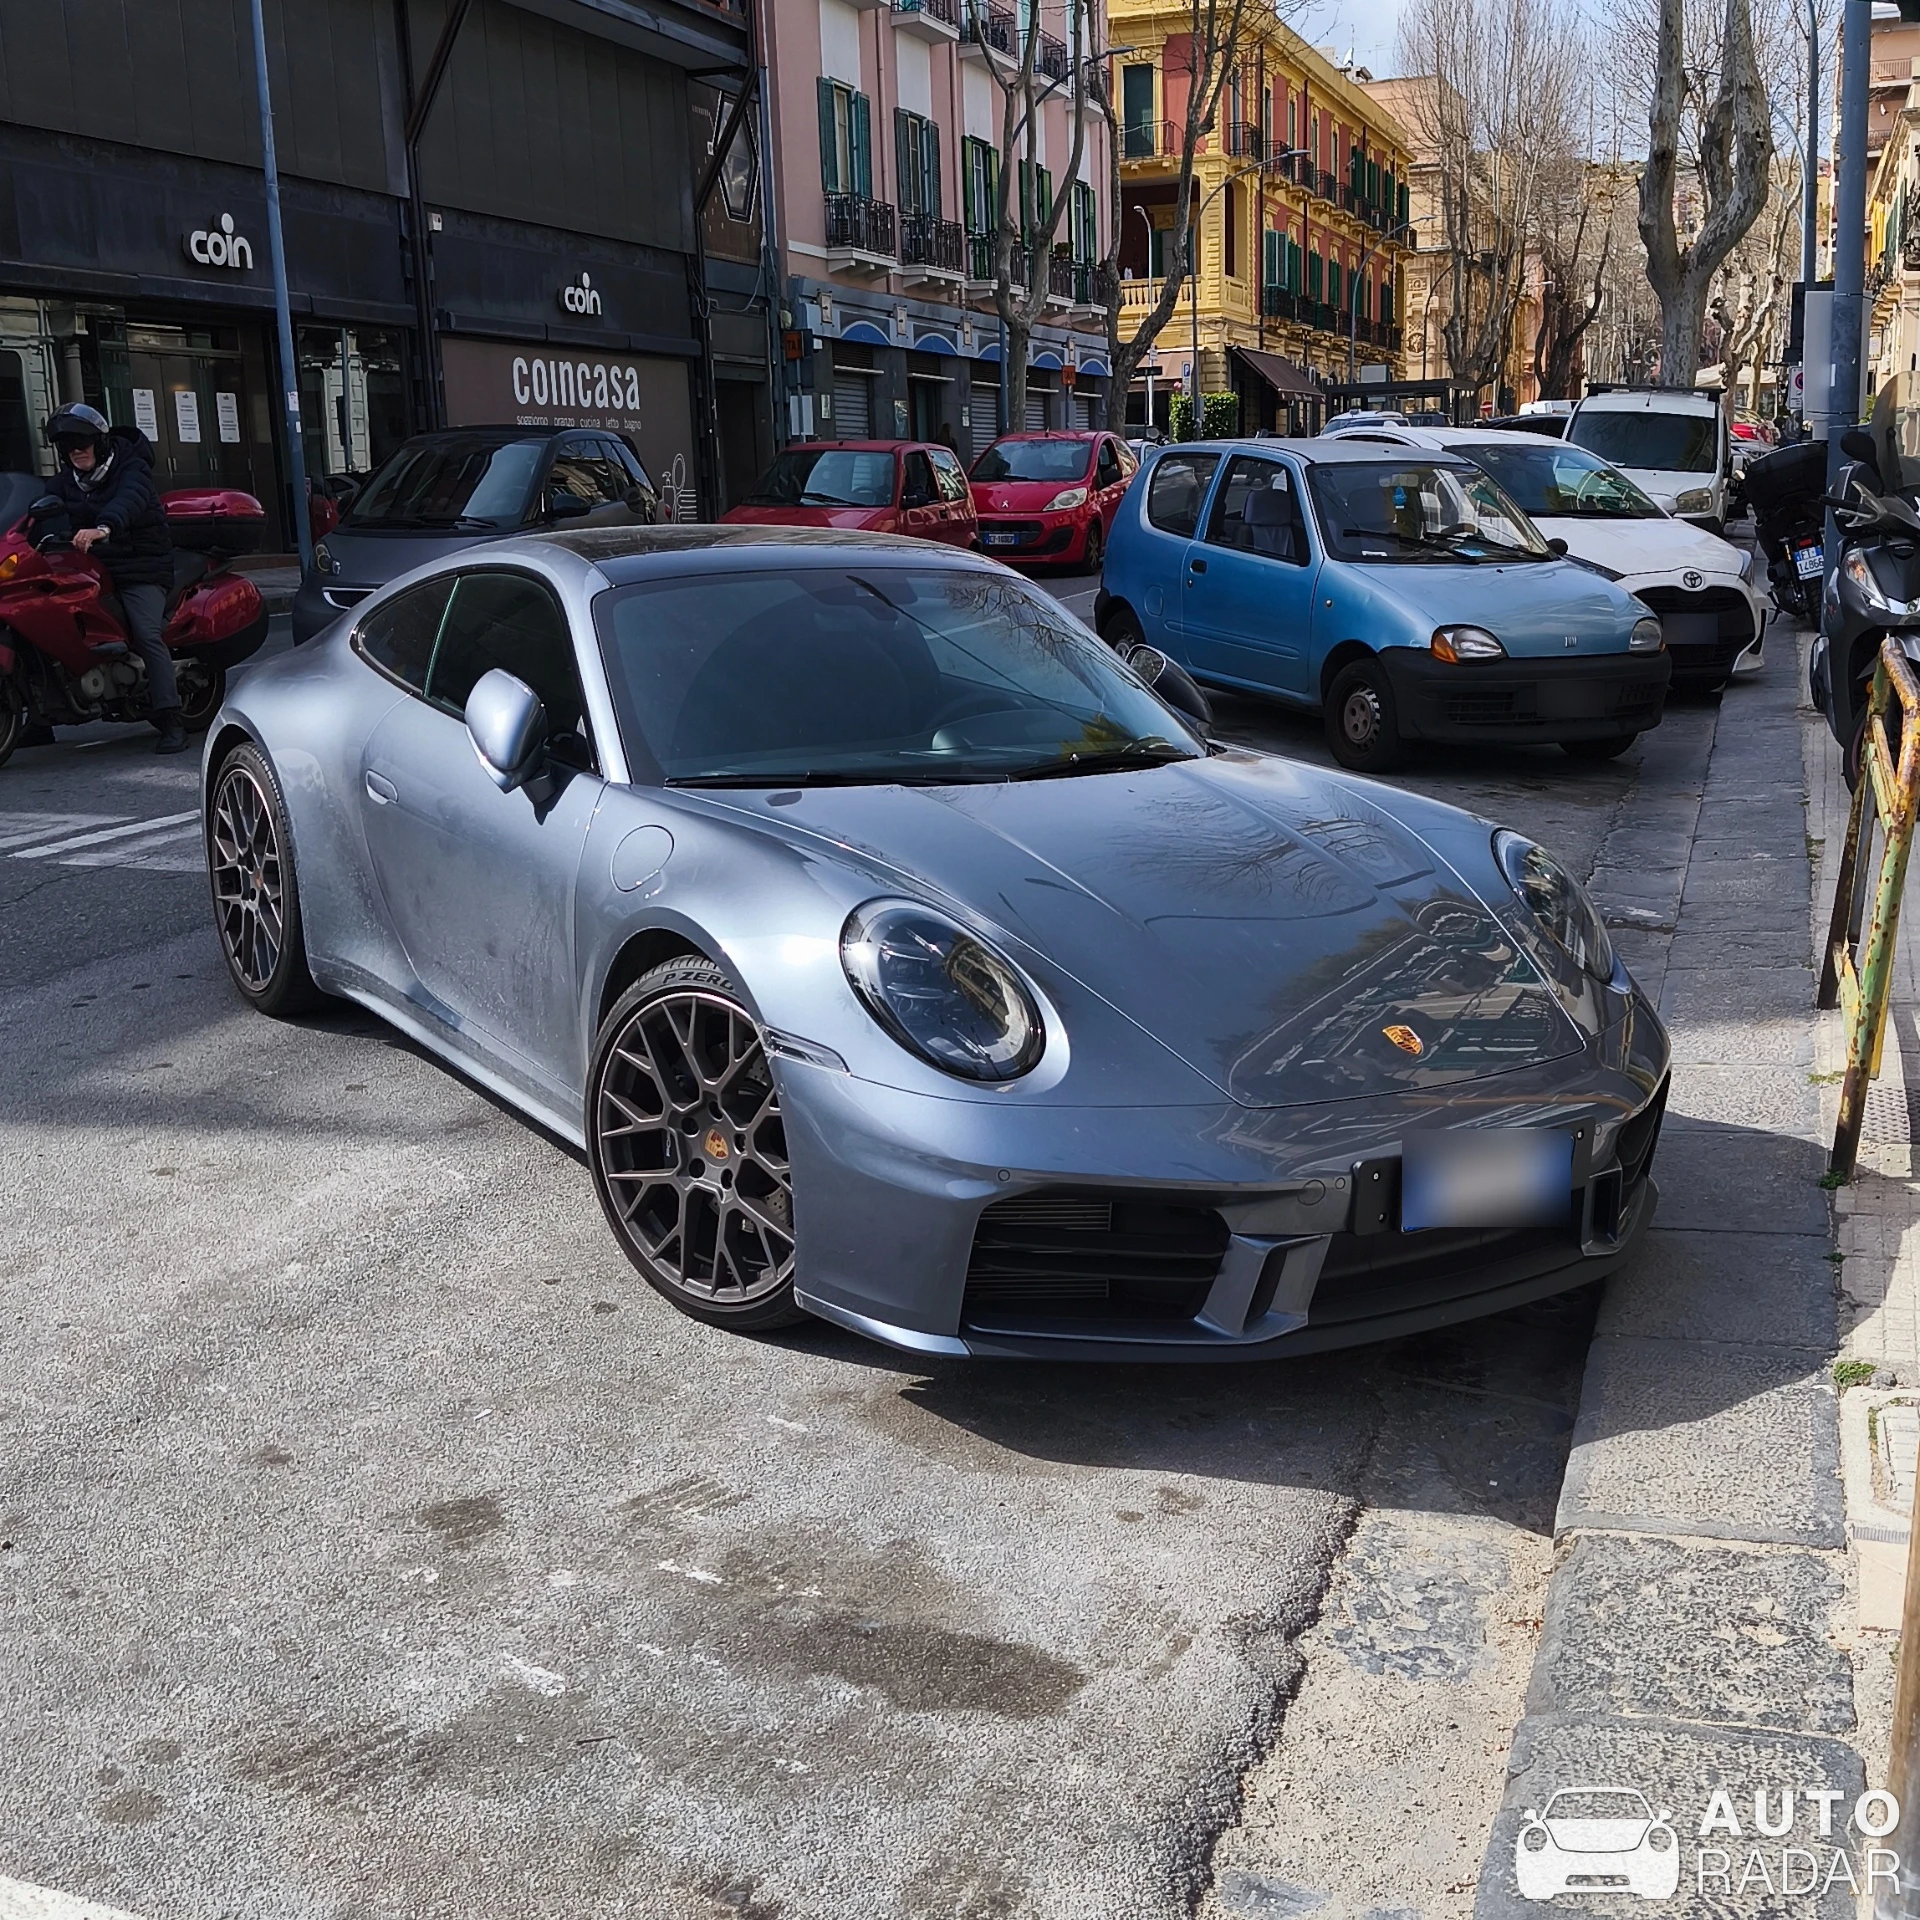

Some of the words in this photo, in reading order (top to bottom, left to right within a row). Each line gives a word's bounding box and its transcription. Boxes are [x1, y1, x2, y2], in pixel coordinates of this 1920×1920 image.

[190, 212, 254, 269] coin
[564, 272, 602, 315] coin
[512, 356, 640, 411] coincasa
[580, 415, 601, 429] cucina
[605, 416, 619, 429] letto
[624, 417, 642, 432] bagno
[662, 972, 677, 984] P
